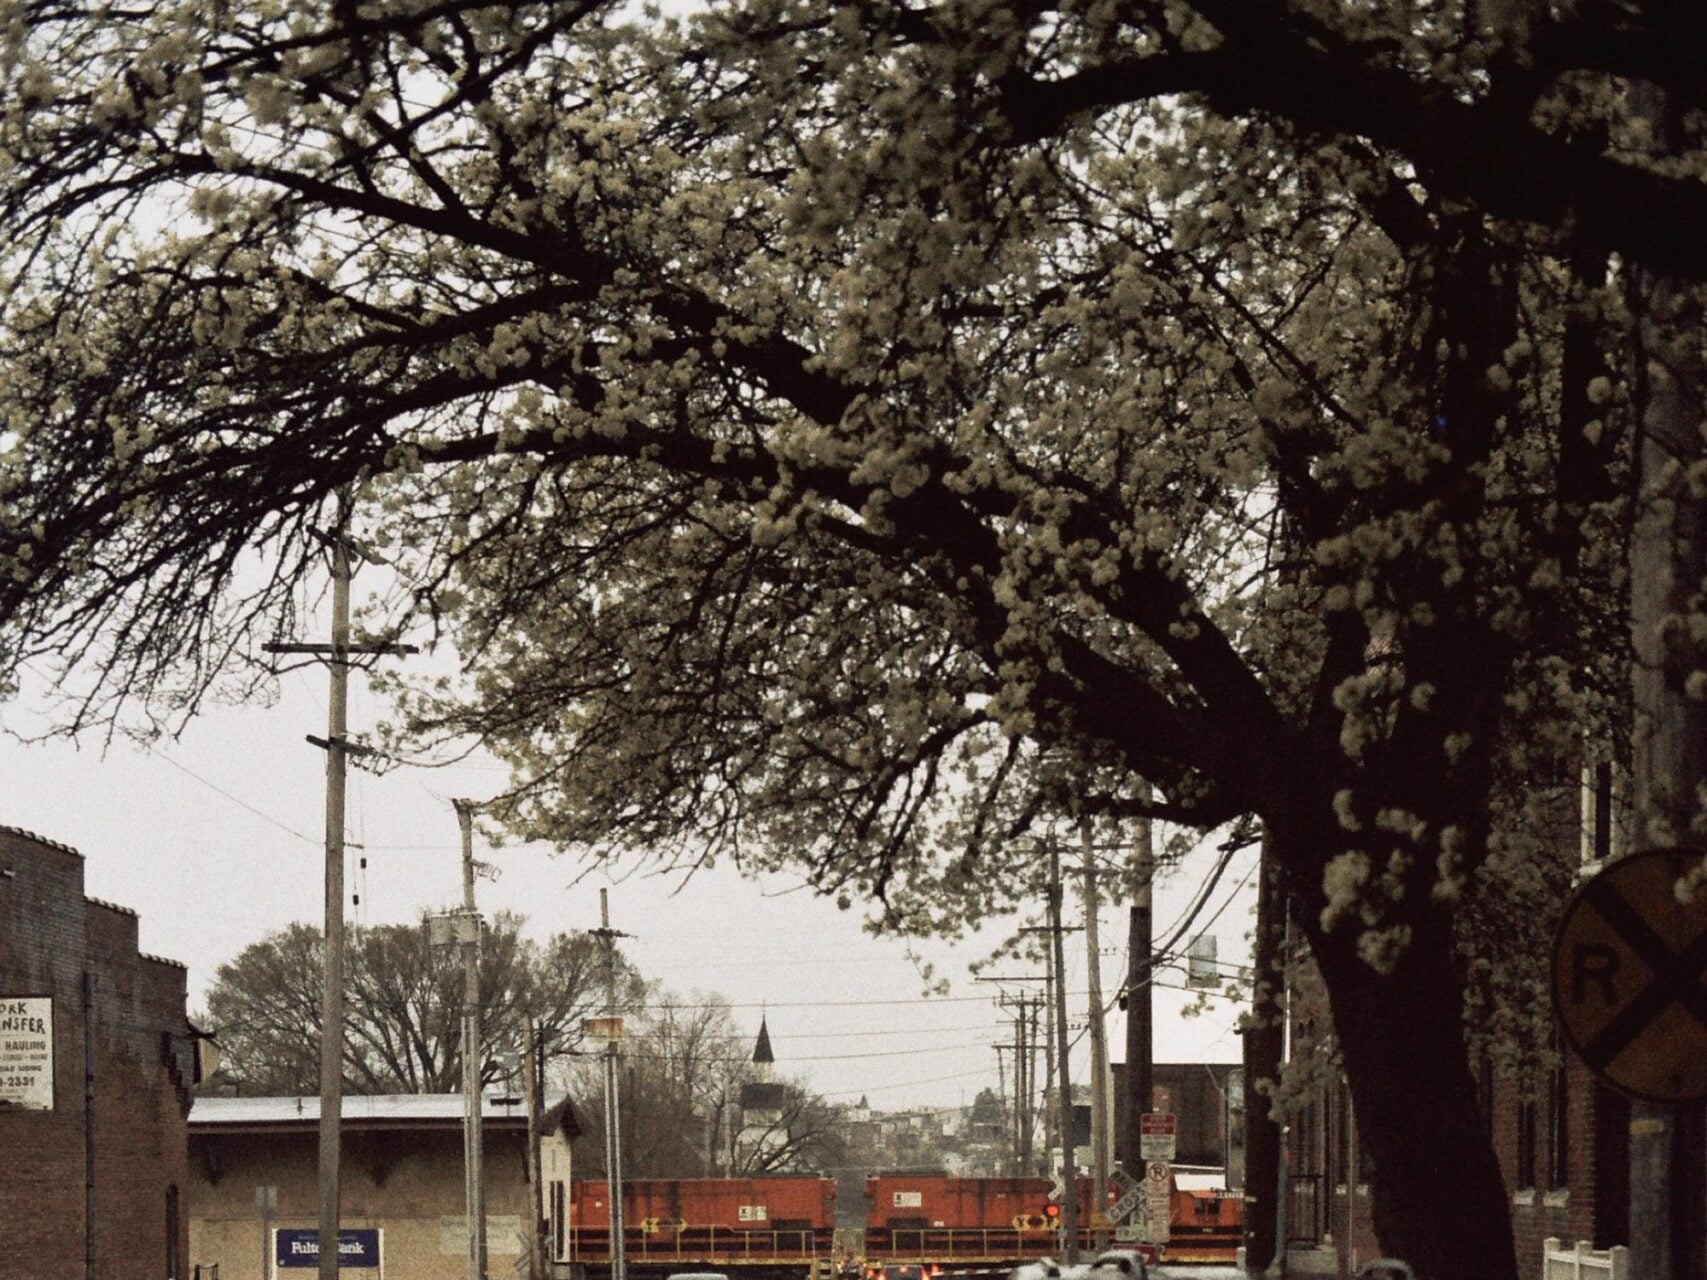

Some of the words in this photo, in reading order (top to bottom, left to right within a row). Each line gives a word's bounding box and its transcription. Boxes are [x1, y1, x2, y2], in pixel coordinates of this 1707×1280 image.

[1573, 944, 1618, 1004] R
[2, 1017, 45, 1034] NSFER
[5, 1041, 46, 1050] HAULING
[1110, 1183, 1147, 1219] CROSS
[291, 1241, 320, 1254] Fulto
